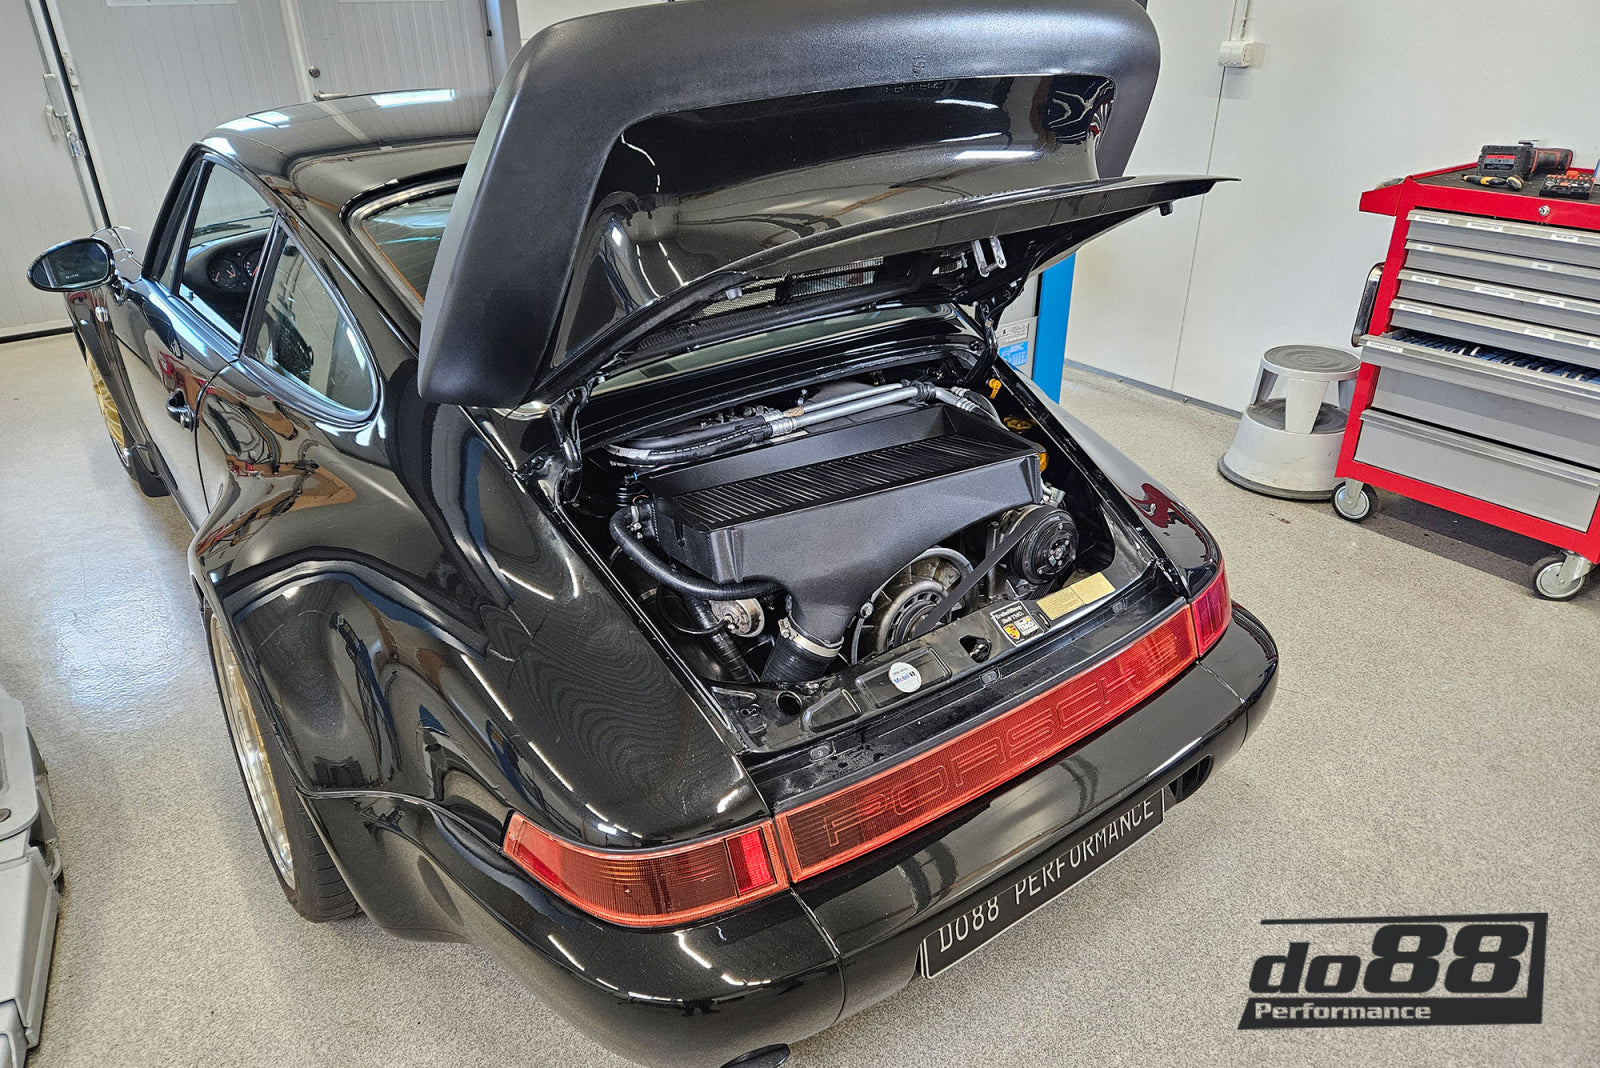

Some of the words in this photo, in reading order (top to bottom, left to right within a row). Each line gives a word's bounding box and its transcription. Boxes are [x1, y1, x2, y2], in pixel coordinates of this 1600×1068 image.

[823, 633, 1178, 847] PORSCHE
[938, 896, 999, 952] DO88
[1014, 799, 1154, 904] PERFORMANCE
